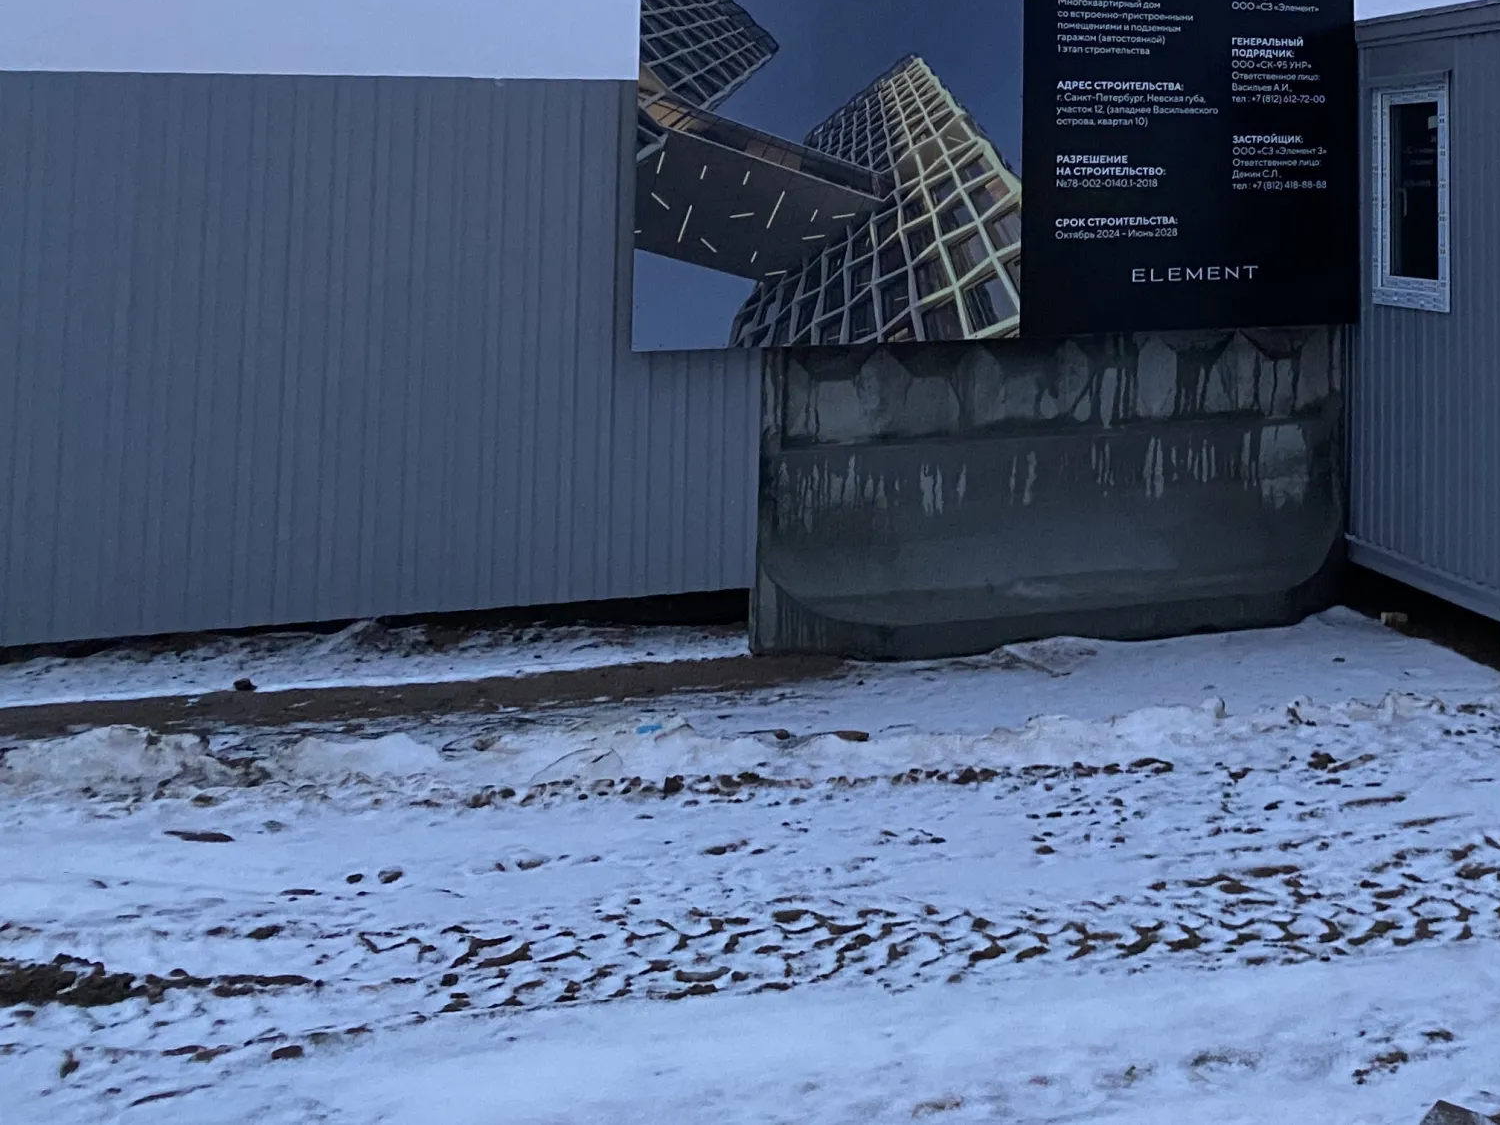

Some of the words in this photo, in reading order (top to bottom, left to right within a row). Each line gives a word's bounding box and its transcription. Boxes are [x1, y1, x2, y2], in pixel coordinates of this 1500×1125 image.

[1143, 1, 1161, 9] дом
[1232, 2, 1255, 10] ООО
[1274, 3, 1320, 13] «Элемент»
[1058, 10, 1069, 18] со
[1071, 11, 1194, 22] встроенно-пристроенными
[1058, 22, 1122, 31] помещениями
[1131, 24, 1181, 33] подземным
[1058, 34, 1097, 43] гаражом
[1098, 34, 1166, 45] (автостоянкой)
[1232, 37, 1304, 46] ГЕНЕРАЛЬНЫЙ
[1085, 46, 1150, 55] строительства
[1232, 49, 1295, 58] ПОДРЯДЧИК:
[1232, 60, 1255, 69] ООО
[1256, 60, 1288, 69] «СК-95
[1289, 61, 1312, 69] УНР»
[1232, 71, 1296, 80] Ответственное
[1057, 81, 1092, 90] АДРЕС
[1094, 82, 1184, 91] СТРОИТЕЛЬСТВА:
[1232, 83, 1272, 92] Васильев
[1064, 93, 1145, 103] Санкт-Петербург,
[1147, 95, 1183, 103] Невская
[1185, 94, 1206, 104] губа,
[1262, 95, 1282, 105] (812)
[1284, 95, 1326, 103] 612-72-00
[1056, 106, 1092, 115] участок
[1095, 106, 1105, 114] 12,
[1107, 106, 1151, 115] (западнее
[1153, 107, 1218, 115] Васильевского
[1056, 118, 1096, 127] острова,
[1098, 118, 1133, 127] квартал
[1135, 117, 1148, 127] 10)
[1233, 133, 1303, 144] ЗАСТРОЙЩИК:
[1233, 147, 1256, 155] ООО
[1057, 155, 1128, 164] РАЗРЕШЕНИЕ
[1233, 158, 1297, 167] Ответственное
[1057, 167, 1071, 176] НА
[1074, 167, 1167, 176] СТРОИТЕЛЬСТВО:
[1056, 179, 1158, 188] №78-002-0140.1-2018
[1253, 181, 1262, 190] +7
[1263, 181, 1283, 191] (812)
[1056, 218, 1085, 227] СРОК
[1088, 216, 1178, 226] СТРОИТЕЛЬСТВА:
[1056, 230, 1095, 240] Октябрь
[1097, 230, 1120, 238] 2024
[1128, 229, 1154, 238] Июнь
[1155, 228, 1178, 237] 2028
[1131, 265, 1259, 283] ELEMENT
